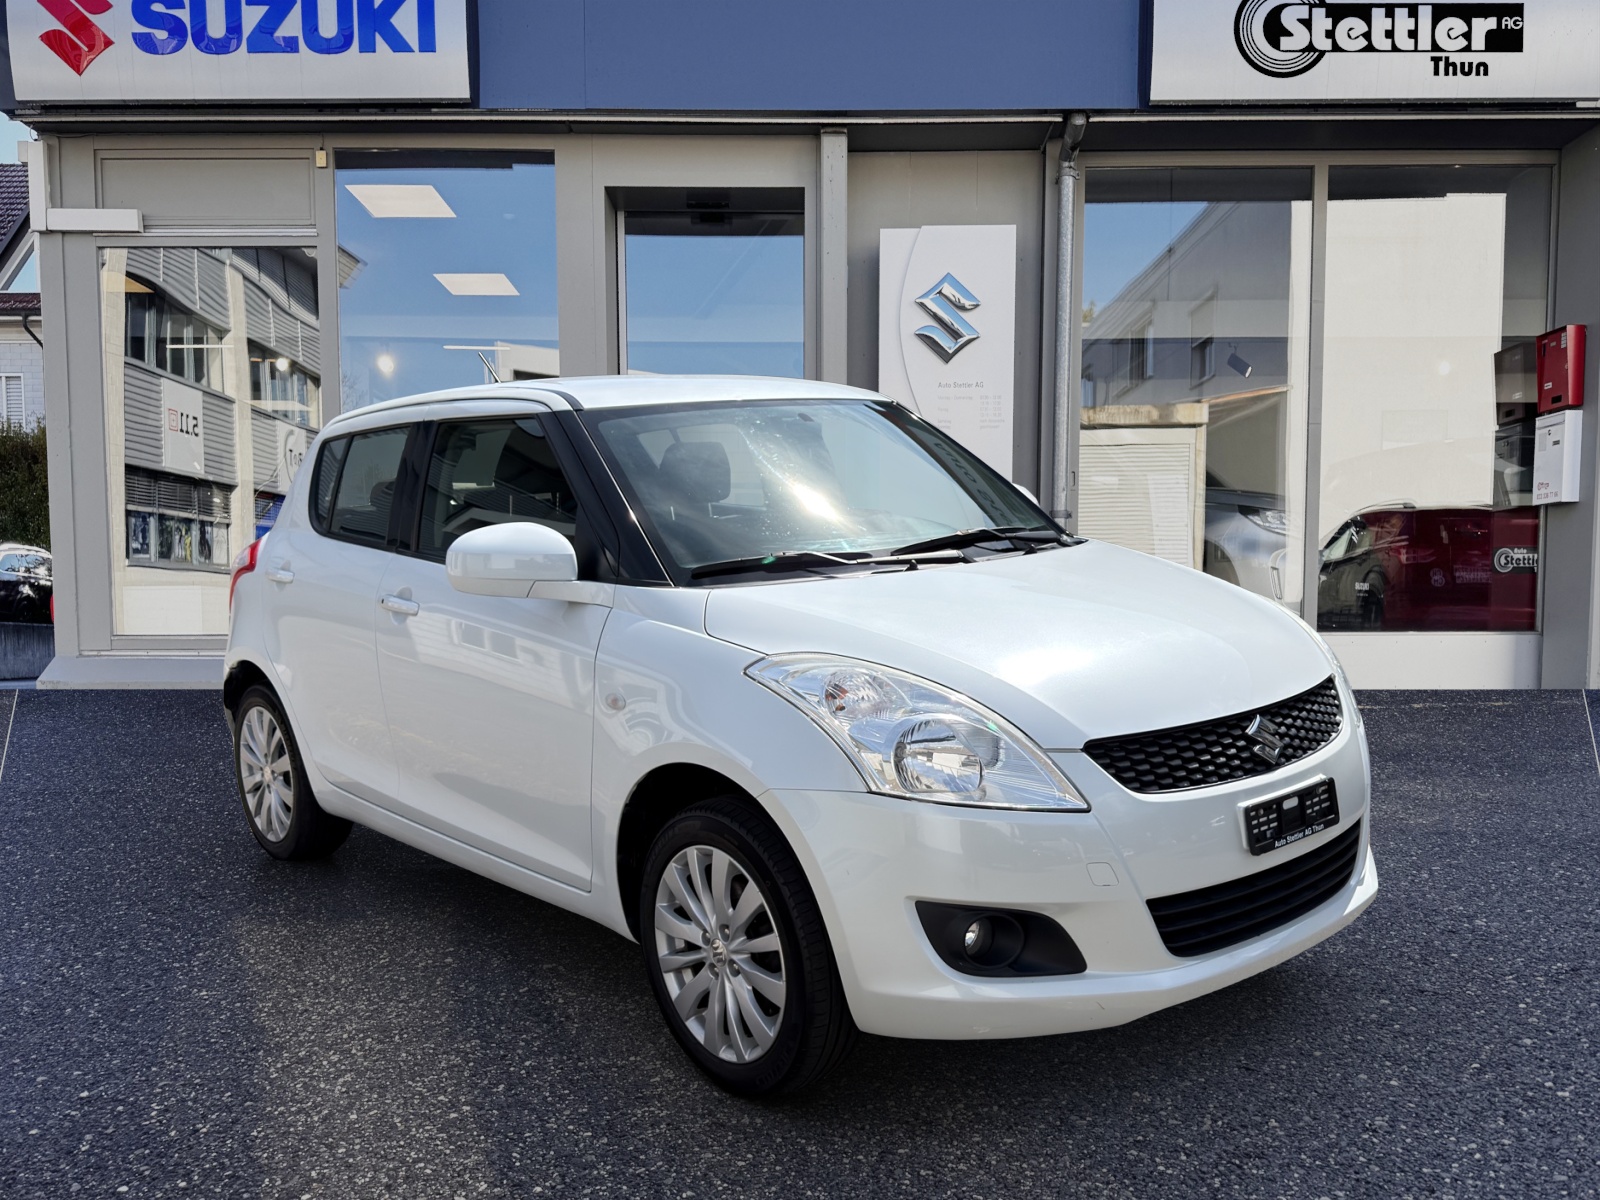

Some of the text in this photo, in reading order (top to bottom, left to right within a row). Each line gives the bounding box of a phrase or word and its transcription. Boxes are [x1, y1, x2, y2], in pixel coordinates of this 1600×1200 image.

[131, 0, 437, 55] SUZUKI
[1279, 4, 1524, 52] Stettler AG
[1430, 56, 1490, 77] Thun
[952, 381, 974, 389] Stettler
[975, 381, 984, 389] AG
[1274, 840, 1286, 848] Auto
[1286, 833, 1304, 843] Stettler
[1312, 823, 1324, 832] Thun
